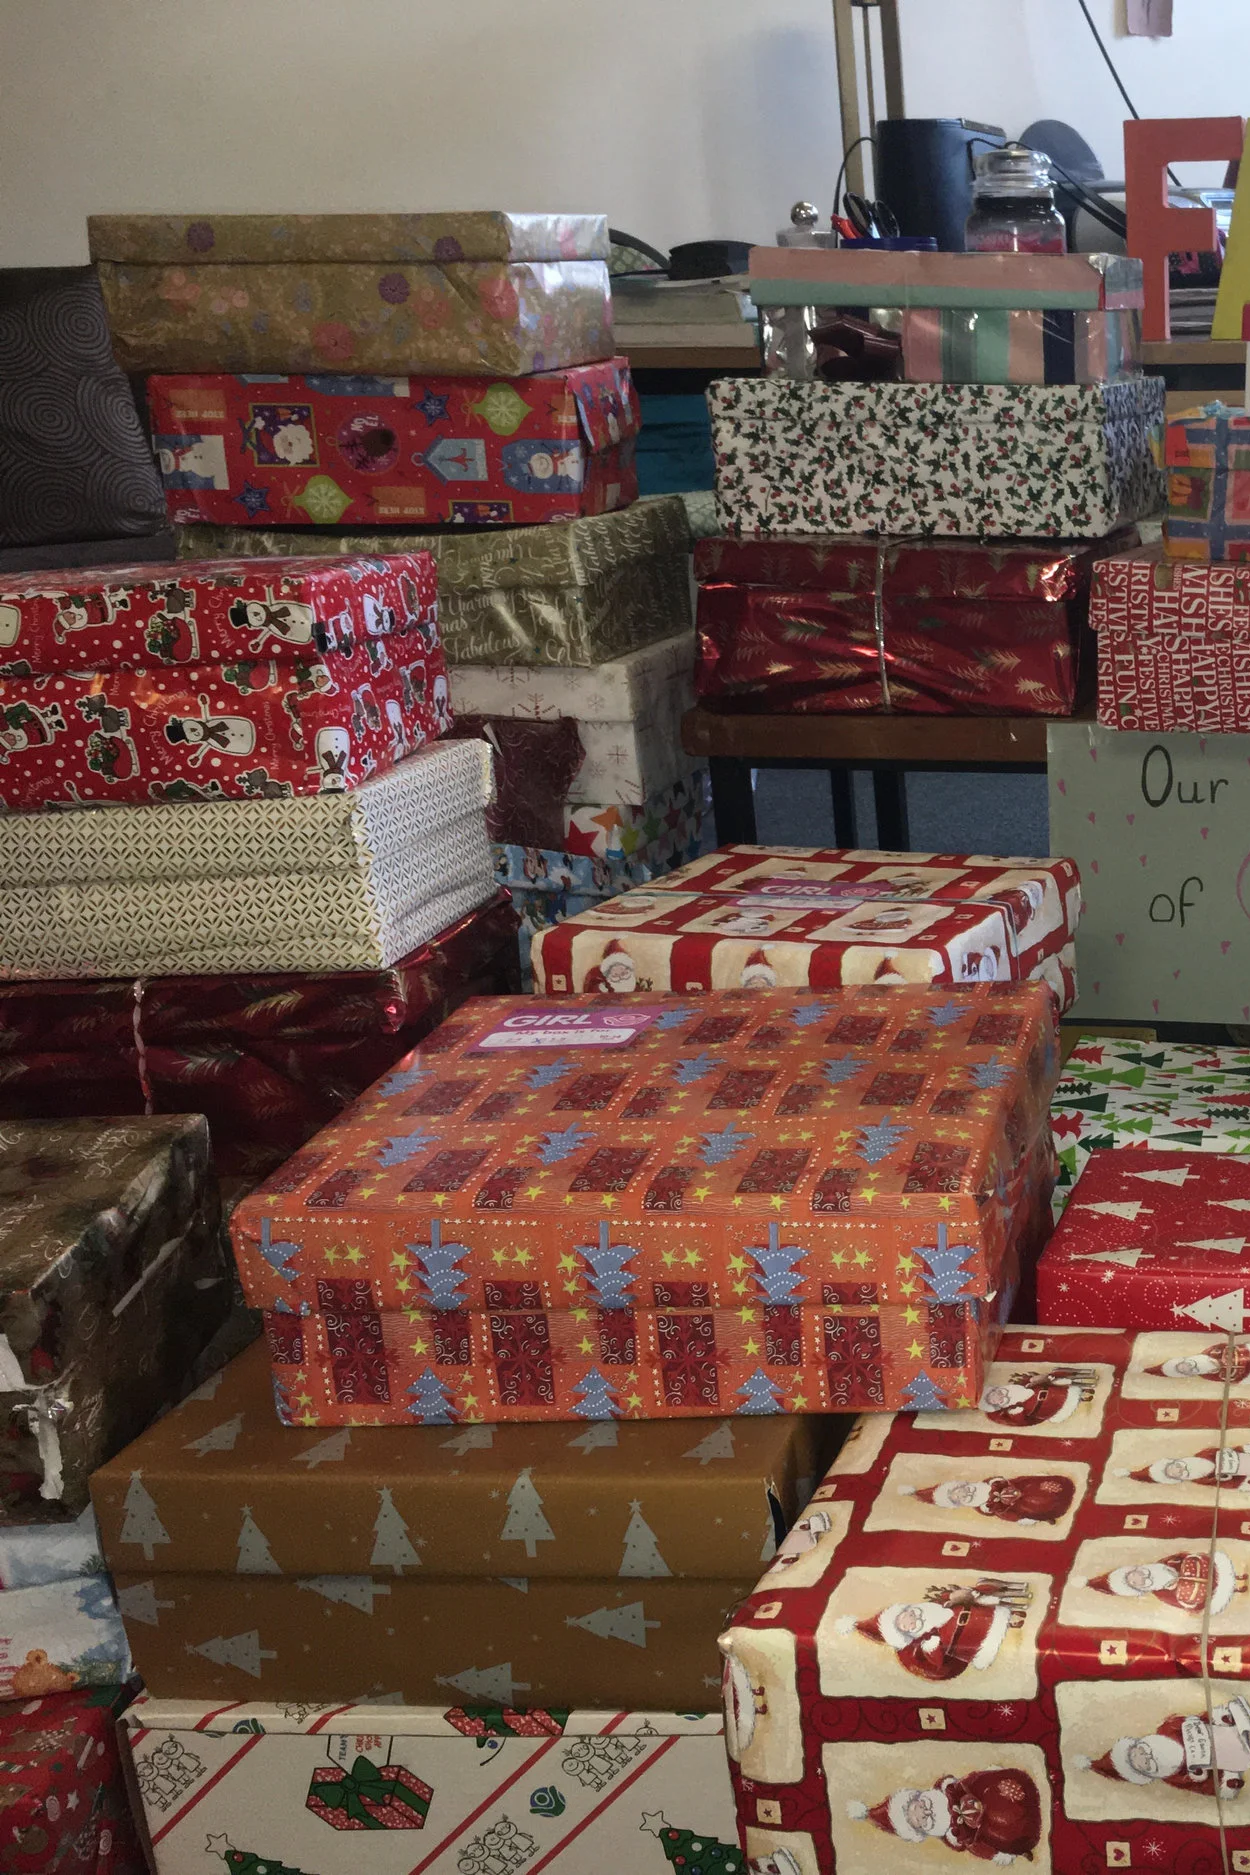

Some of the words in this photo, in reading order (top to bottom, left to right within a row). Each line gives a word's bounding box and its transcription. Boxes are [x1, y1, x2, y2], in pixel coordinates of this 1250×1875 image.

[1114, 654, 1139, 704] FUN
[1141, 744, 1229, 808] Our
[761, 885, 832, 896] GIRL
[1149, 876, 1204, 928] of
[503, 1014, 592, 1027] GIRL
